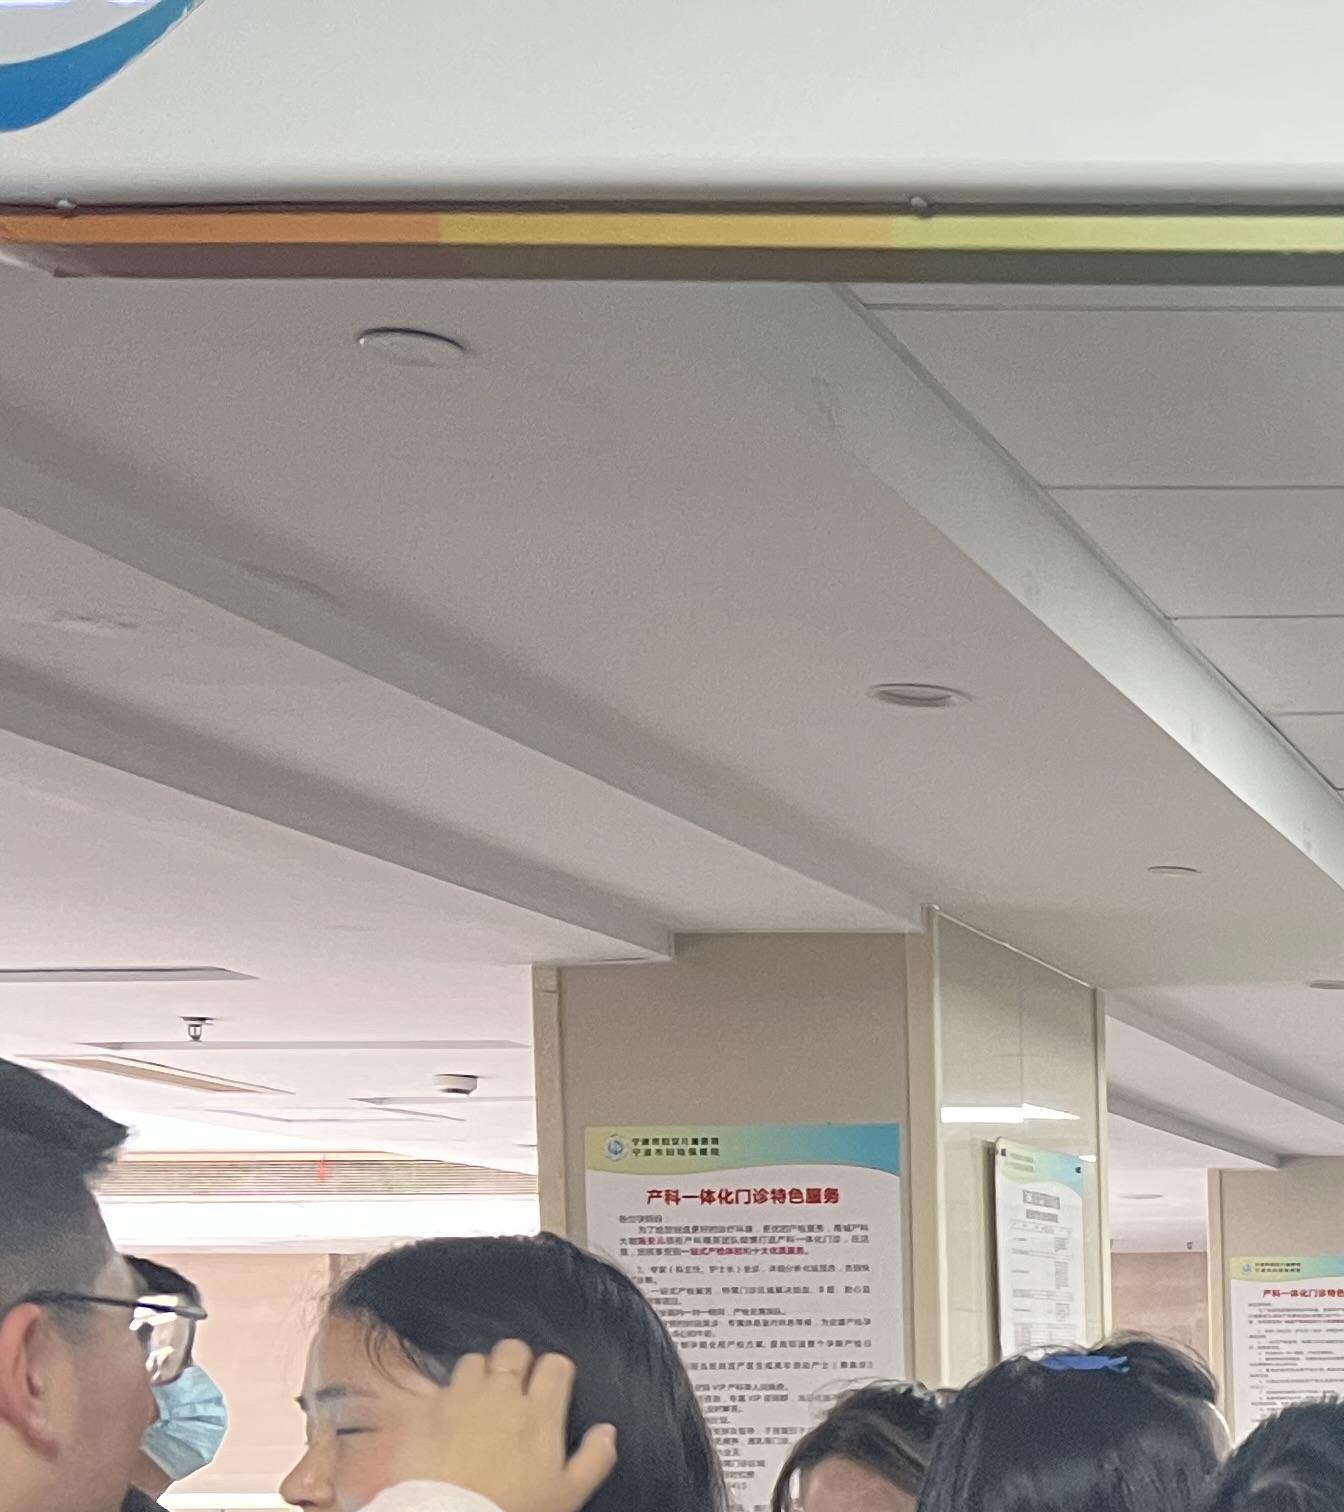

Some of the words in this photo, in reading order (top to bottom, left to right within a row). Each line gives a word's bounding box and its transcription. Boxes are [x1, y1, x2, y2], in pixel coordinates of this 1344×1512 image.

[646, 1187, 841, 1206] 产科一体化门诊特色服务
